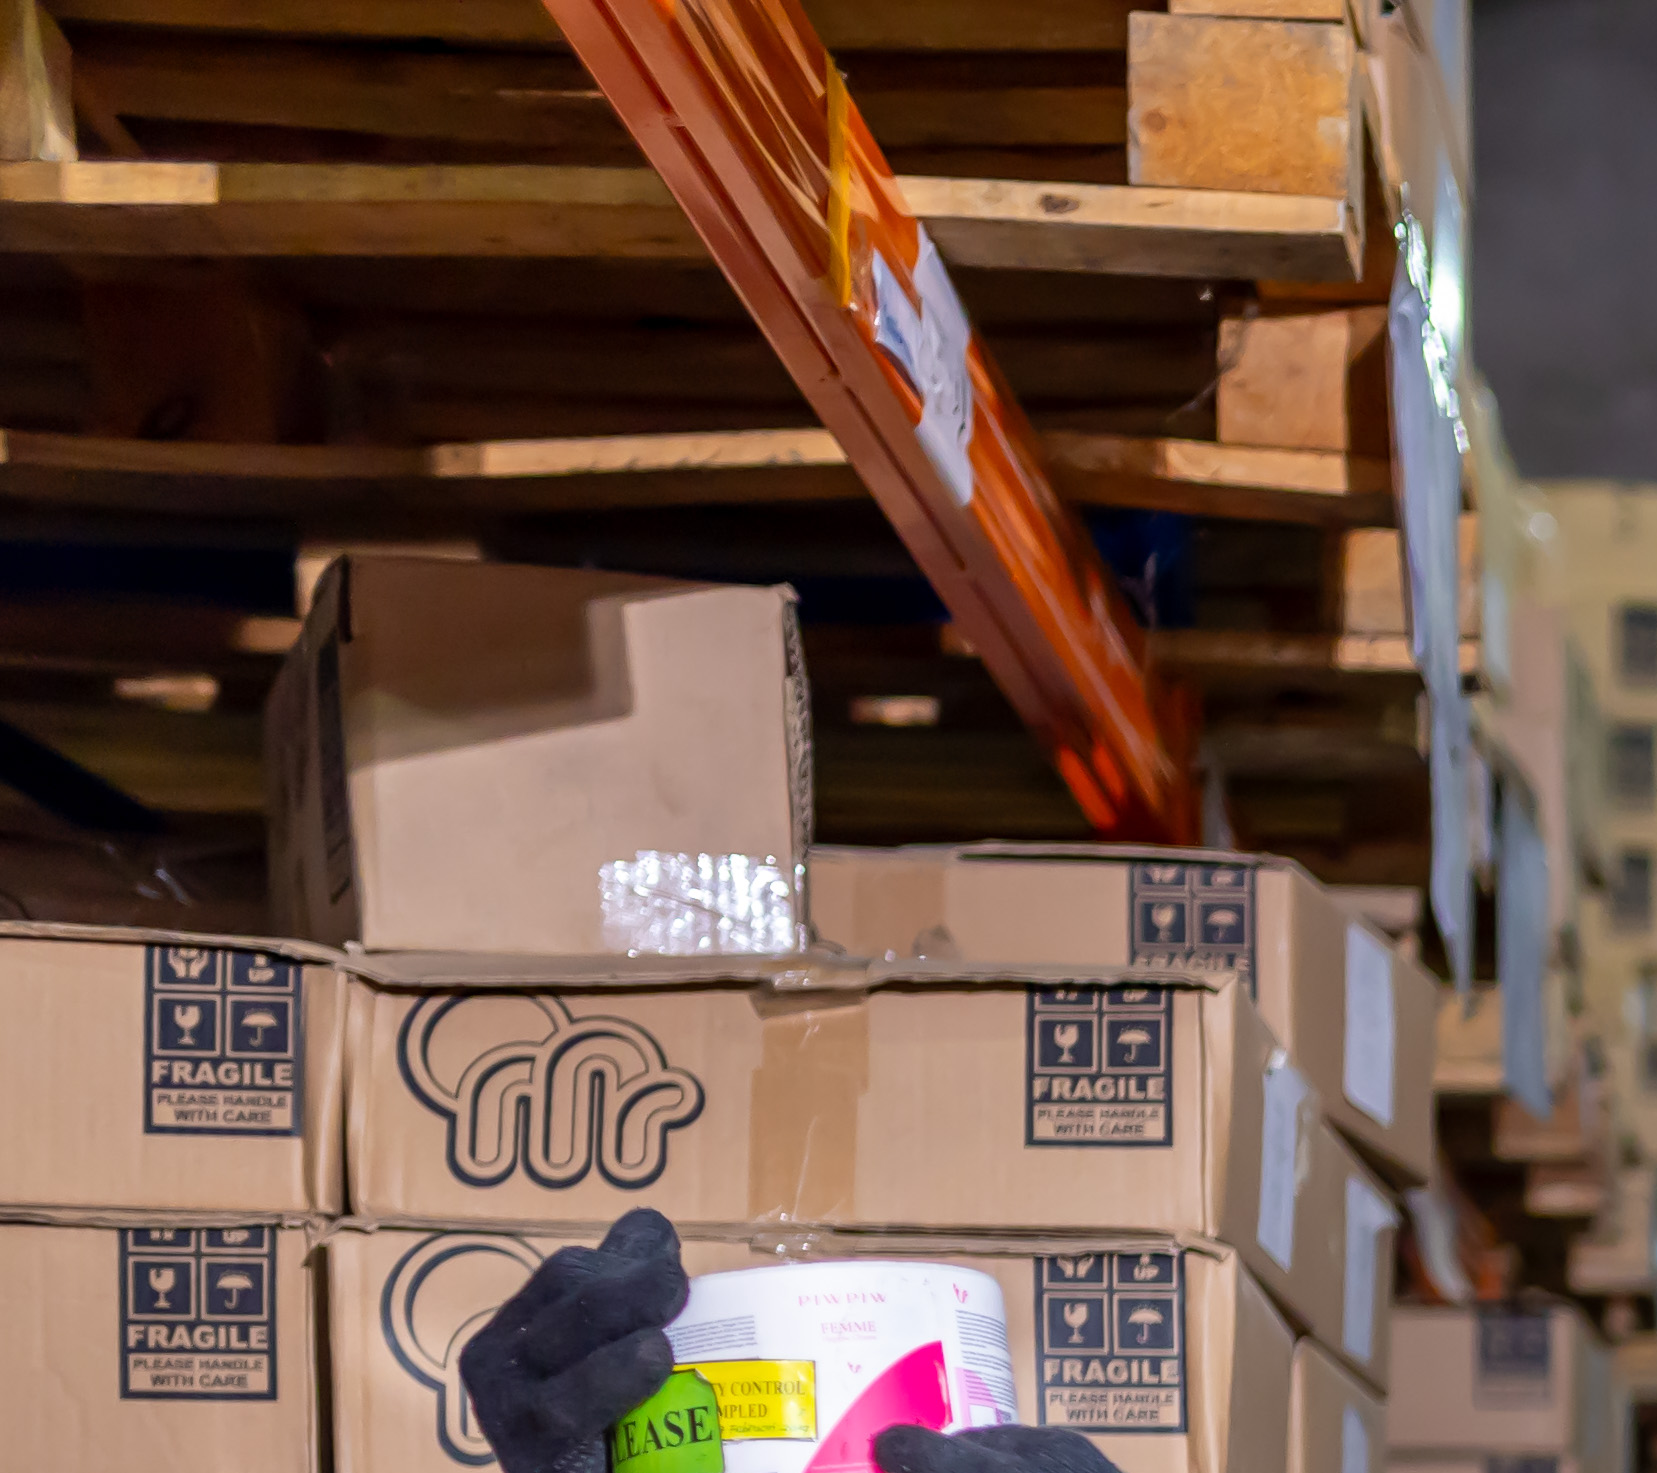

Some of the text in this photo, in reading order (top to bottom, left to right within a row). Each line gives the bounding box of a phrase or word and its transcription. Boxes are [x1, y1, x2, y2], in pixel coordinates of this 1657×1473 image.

[152, 1060, 293, 1087] FRAGILE
[1033, 1077, 1166, 1100] FRAGILE
[174, 1109, 271, 1123] WITH CARE
[127, 1324, 268, 1350] FRAGILE
[133, 1358, 263, 1370] PLEASE HANDLE
[1043, 1358, 1179, 1384] FRAGILE
[151, 1374, 248, 1388] WITH CARE
[731, 1380, 806, 1398] CONTROL
[717, 1403, 768, 1420] MPLED
